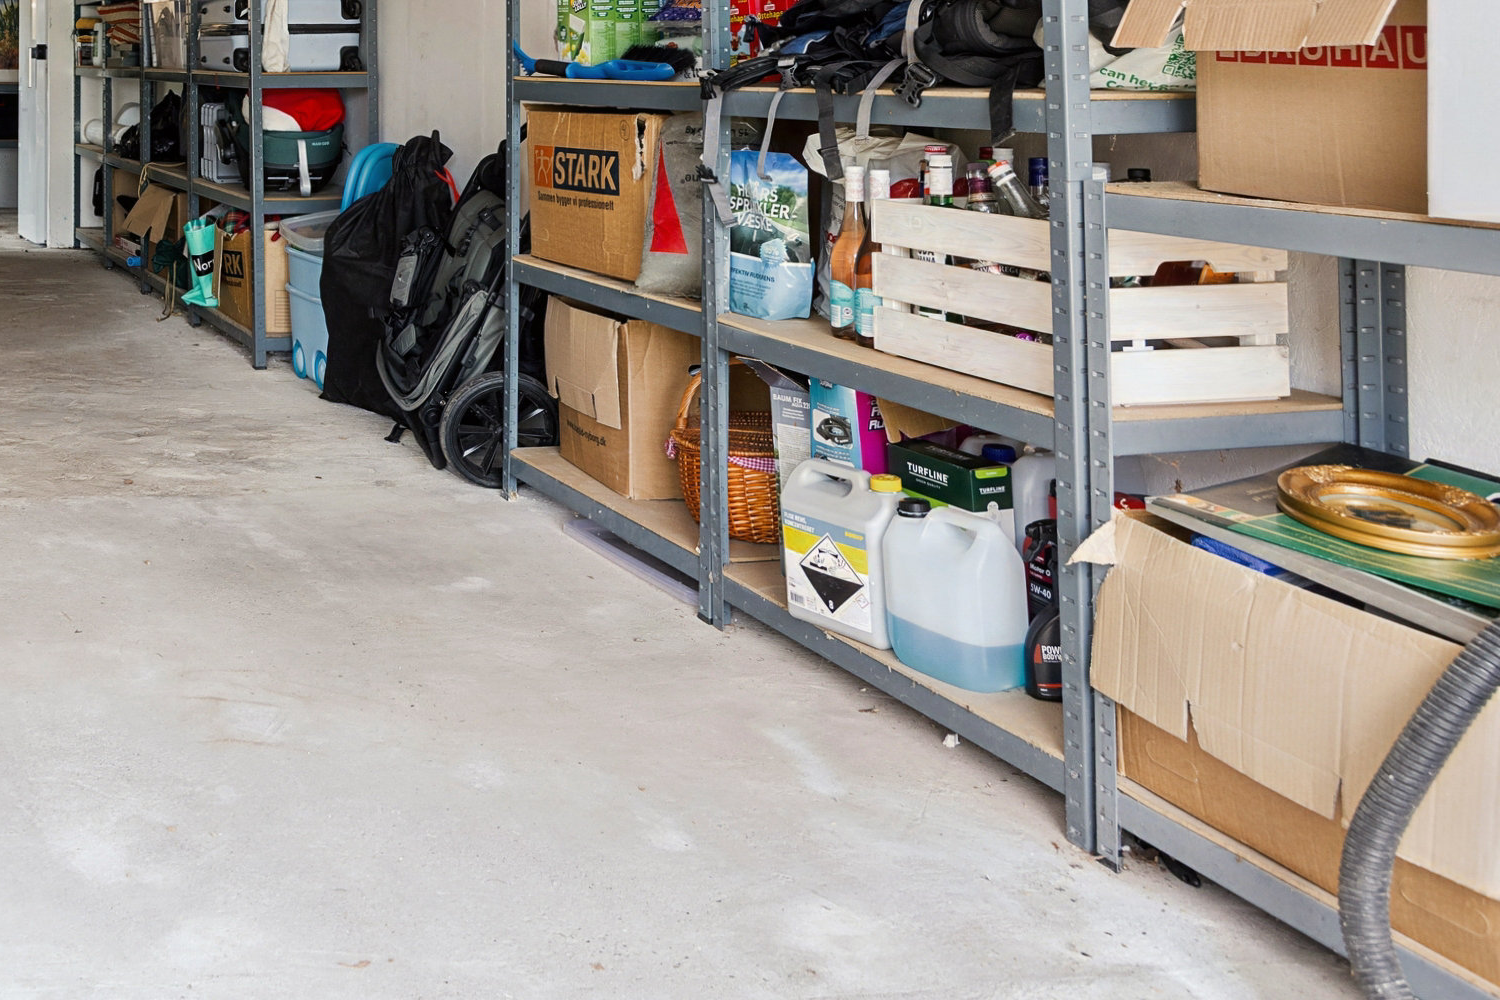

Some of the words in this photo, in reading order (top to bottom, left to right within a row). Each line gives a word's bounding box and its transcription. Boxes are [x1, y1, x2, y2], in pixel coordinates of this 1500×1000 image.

[1100, 67, 1126, 81] can
[554, 151, 617, 191] STARK
[736, 214, 774, 233] VÆSKE
[193, 257, 215, 272] Nor
[772, 393, 792, 404] BAUM
[793, 396, 803, 404] FIX
[906, 461, 949, 484] TURFLINE
[979, 485, 1006, 494] TURFLINE
[1030, 582, 1052, 600] 5W-40
[1041, 645, 1062, 655] POW
